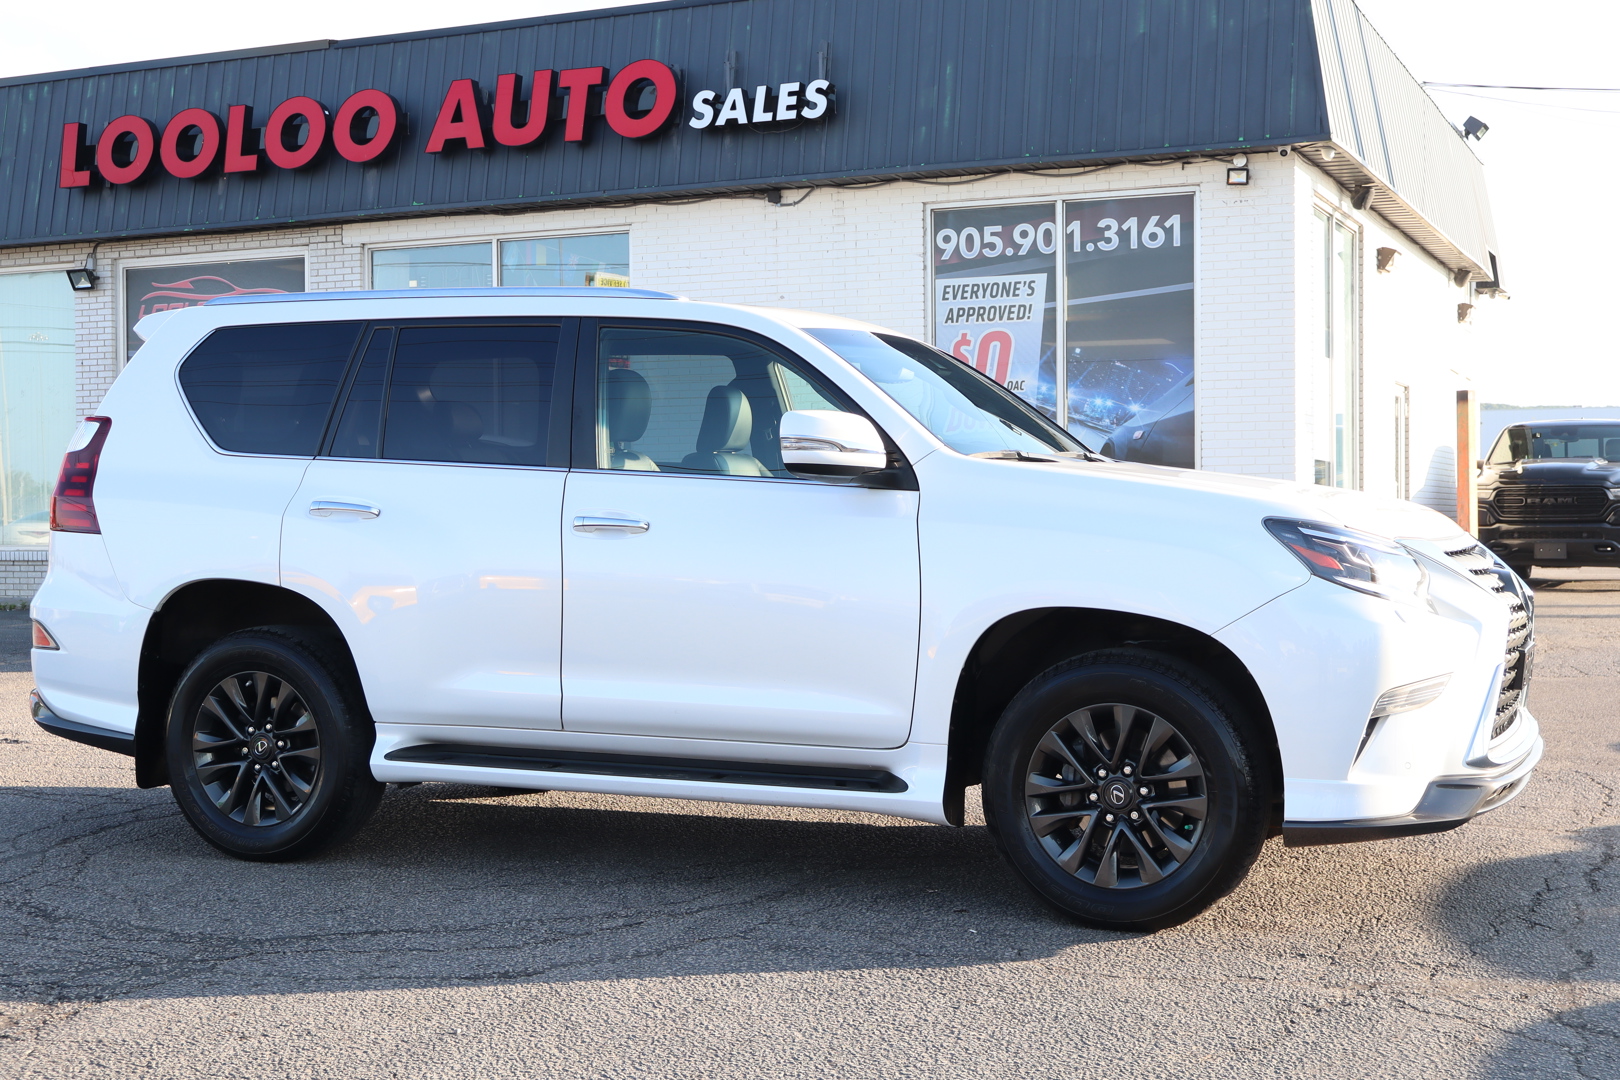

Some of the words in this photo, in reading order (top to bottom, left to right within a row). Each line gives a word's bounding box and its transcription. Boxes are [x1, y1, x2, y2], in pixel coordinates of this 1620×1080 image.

[60, 88, 397, 188] LOOLOO
[426, 59, 677, 153] AUTO
[689, 79, 831, 129] SALES
[935, 214, 1182, 261] 905.901.3161
[942, 280, 1035, 301] EVERYONE'S
[945, 304, 1032, 324] APPROVED!
[952, 330, 1012, 386] $0
[1006, 379, 1025, 391] OAC
[1527, 497, 1573, 505] RAM
